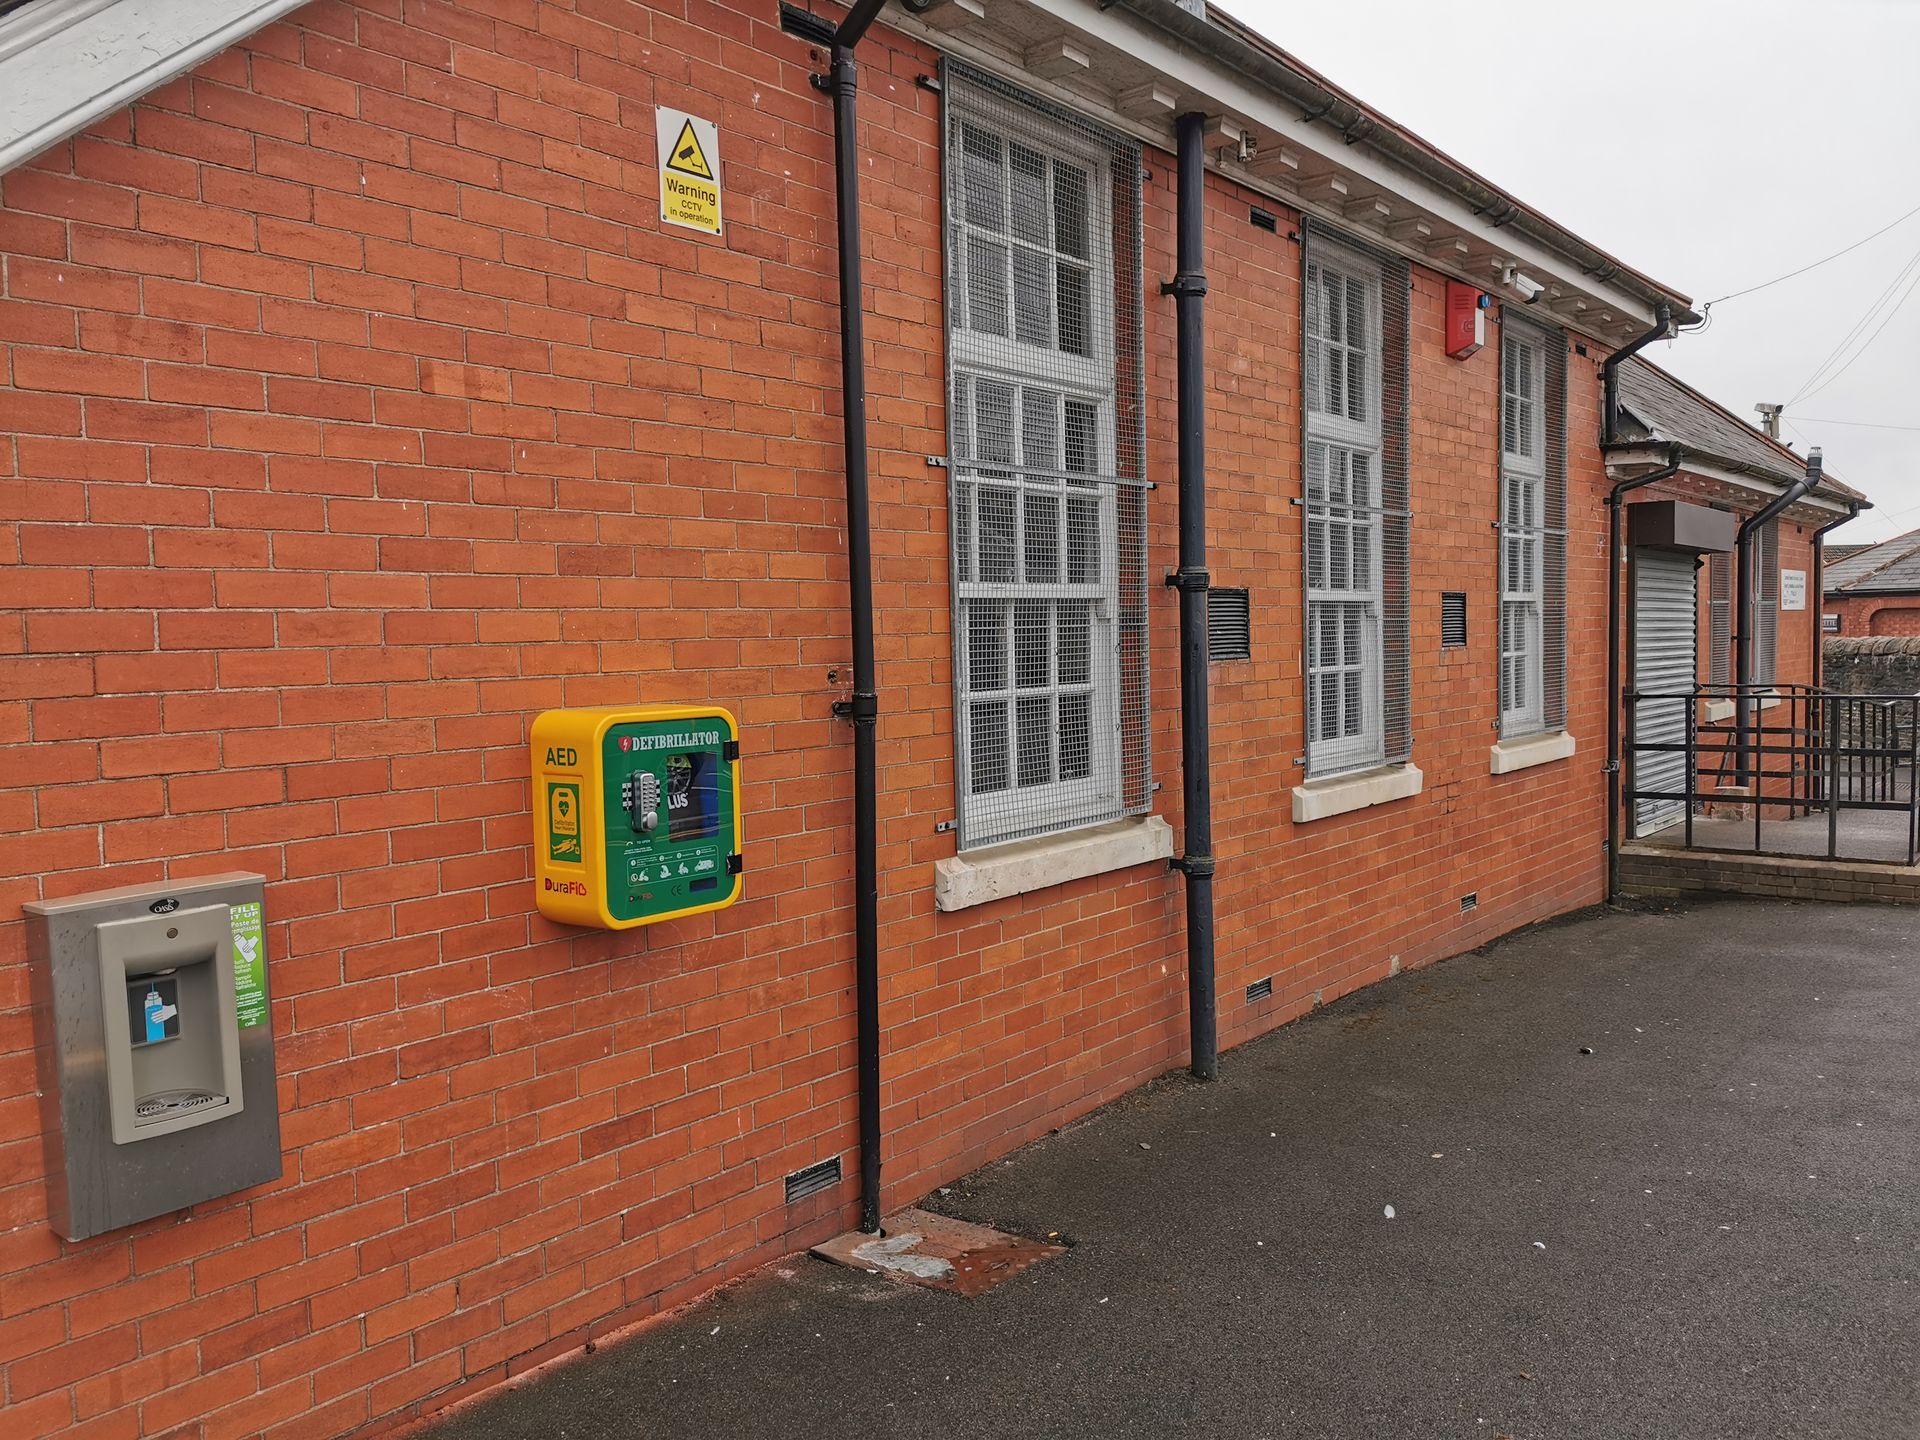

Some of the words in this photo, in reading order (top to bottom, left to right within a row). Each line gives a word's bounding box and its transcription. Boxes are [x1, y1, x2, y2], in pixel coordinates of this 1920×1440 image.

[666, 177, 716, 206] Warning
[681, 199, 702, 212] CCTV
[670, 206, 678, 216] in
[679, 211, 713, 225] operation
[632, 731, 720, 751] DEFIBRILLATOR
[545, 747, 577, 767] AED
[230, 904, 258, 915] FILL
